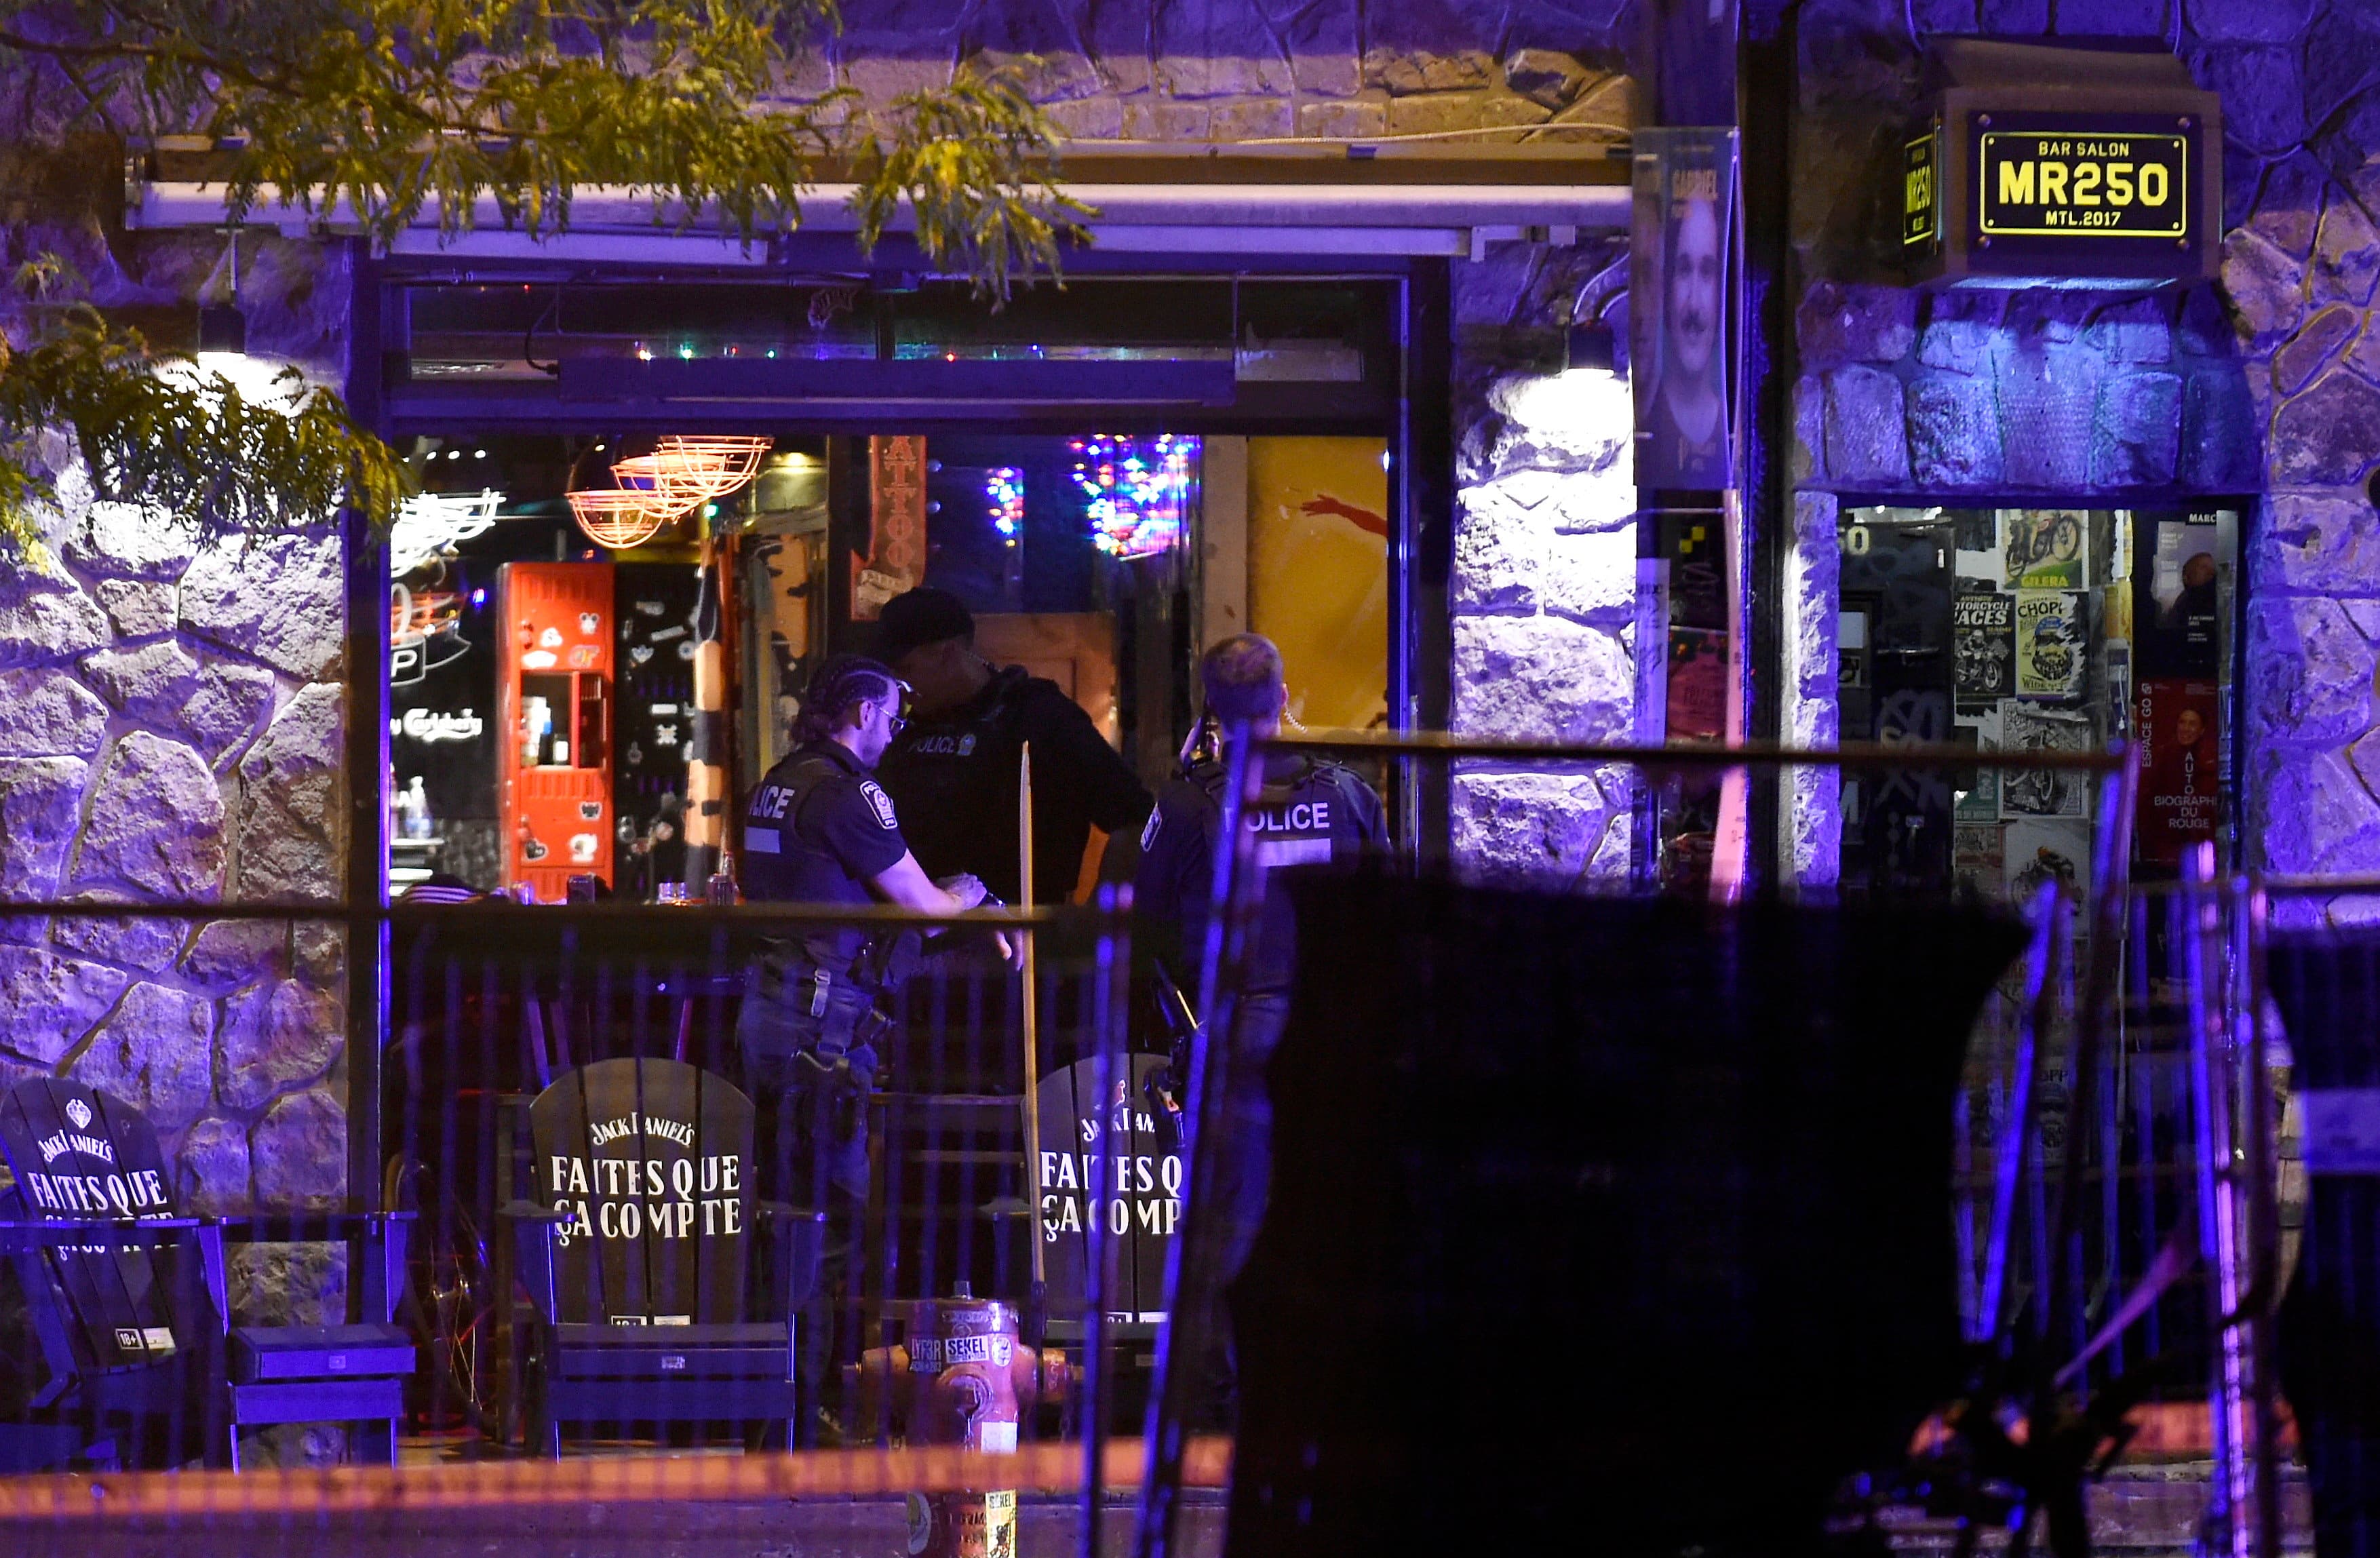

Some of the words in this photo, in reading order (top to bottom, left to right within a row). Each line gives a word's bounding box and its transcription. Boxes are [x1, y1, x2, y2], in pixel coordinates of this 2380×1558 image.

[2038, 142, 2070, 157] BAR
[2077, 142, 2129, 157] SALON
[1999, 160, 2168, 206] MR250
[2046, 211, 2121, 227] MTL.2017
[1954, 610, 2007, 625] ACES
[403, 707, 483, 743] Carlsberg
[2142, 721, 2152, 768] ESPACE
[2168, 817, 2210, 829] ROUGE
[2181, 807, 2198, 817] DU
[591, 1117, 629, 1146] JACK
[38, 1133, 64, 1163] JACK
[551, 1155, 665, 1195] FAITES
[673, 1154, 741, 1200] QUE
[1040, 1151, 1154, 1192] FAIES
[28, 1171, 109, 1211] FAITES
[106, 1170, 168, 1216] QUE
[600, 1198, 743, 1239] COMPTE
[119, 1333, 137, 1346] 18+
